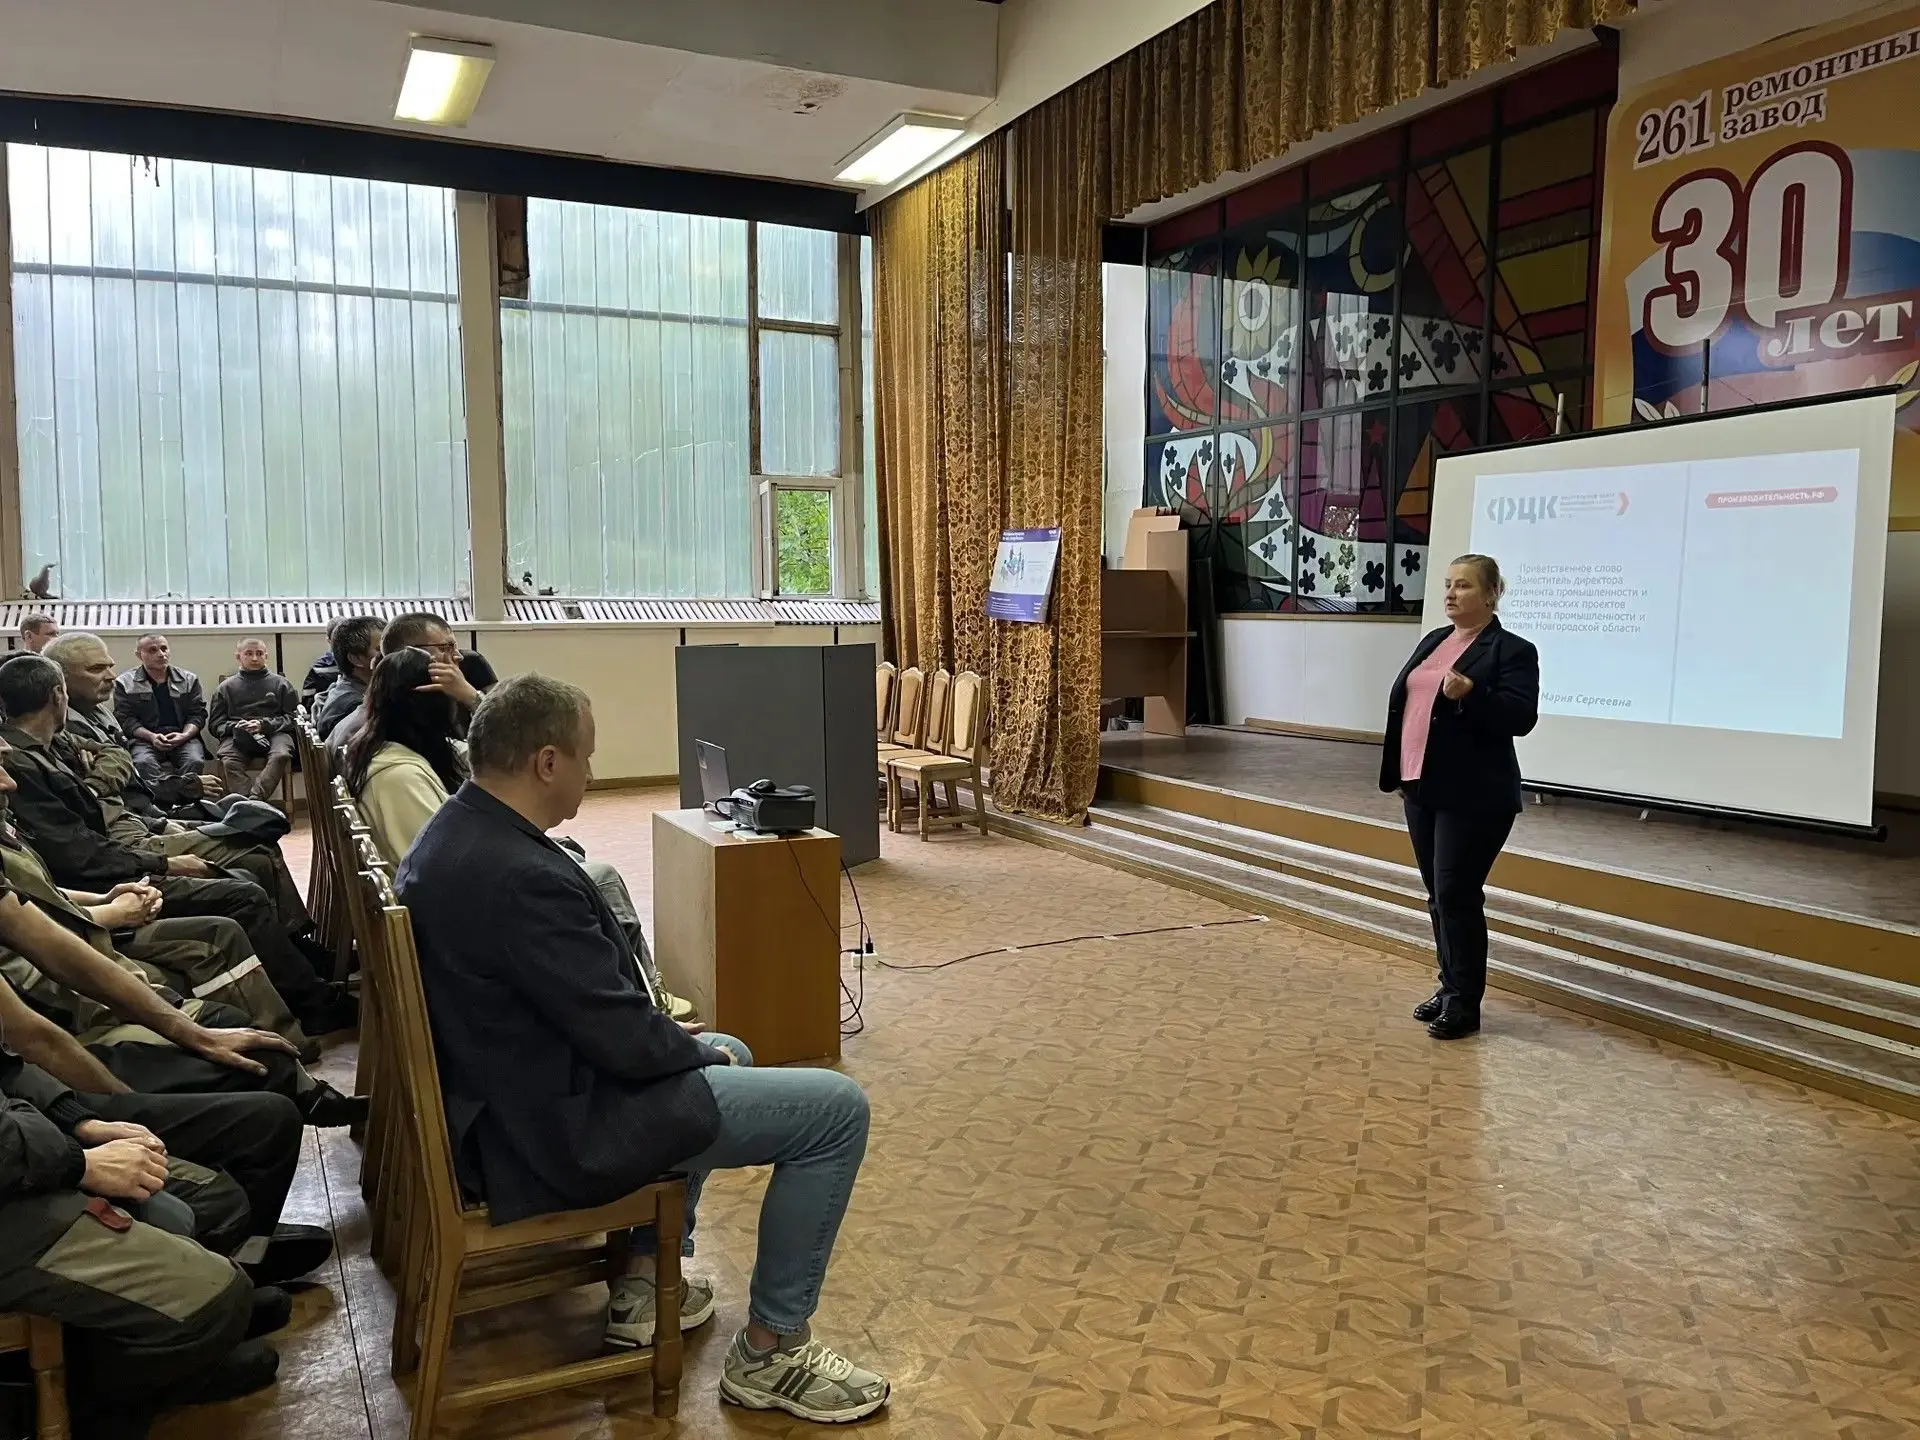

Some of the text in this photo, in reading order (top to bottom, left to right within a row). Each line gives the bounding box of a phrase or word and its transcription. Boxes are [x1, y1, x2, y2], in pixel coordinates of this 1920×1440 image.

[1722, 92, 1824, 140] завод
[1638, 96, 1709, 163] 261
[1644, 141, 1853, 356] 30
[1767, 301, 1913, 357] лет
[1487, 496, 1558, 524] ФЦК
[1520, 564, 1622, 574] Приветственное слово
[1516, 575, 1624, 587] Заместитель директора
[1556, 588, 1638, 598] промышленности
[1510, 599, 1626, 610] стратегических проектов
[1554, 611, 1636, 622] промышленности
[1535, 621, 1600, 632] Новгородской
[1602, 622, 1641, 633] области
[1541, 692, 1632, 708] Мария Сергеевна
